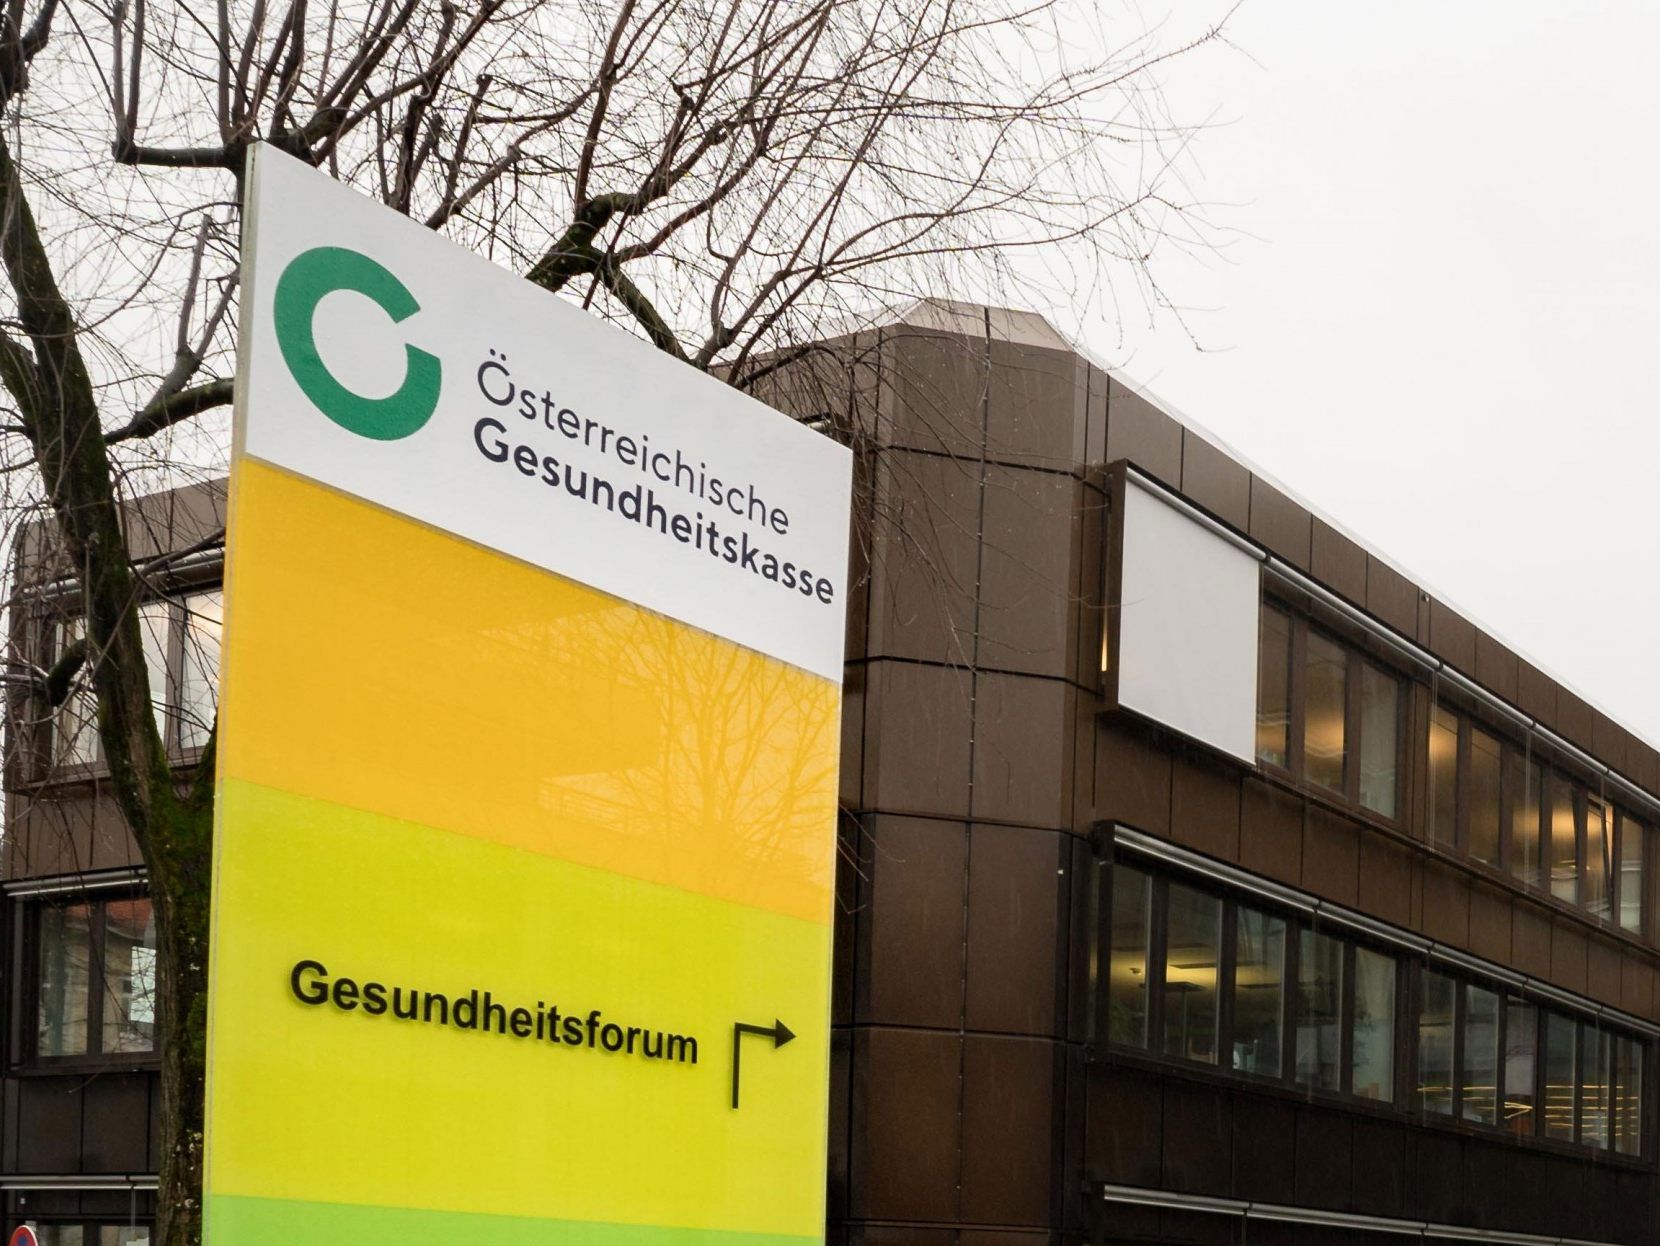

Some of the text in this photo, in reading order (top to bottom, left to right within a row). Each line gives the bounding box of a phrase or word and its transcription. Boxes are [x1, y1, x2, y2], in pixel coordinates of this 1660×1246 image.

[473, 417, 835, 605] Gesundheitskasse
[477, 348, 790, 536] Österreichische
[290, 959, 699, 1064] Gesundheitsforum
